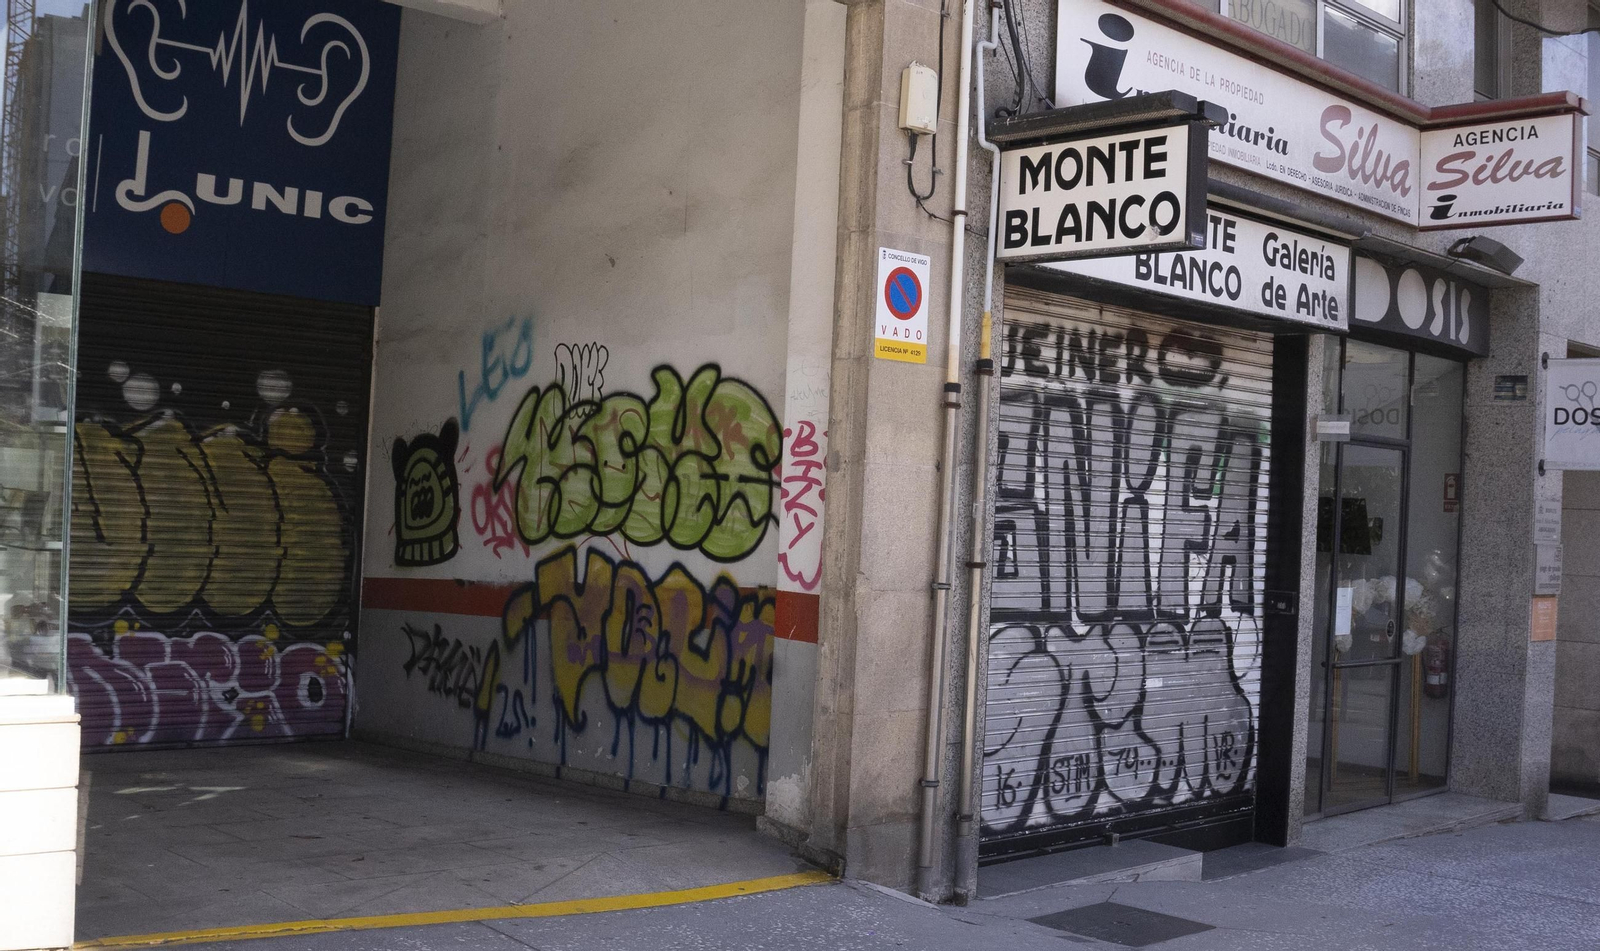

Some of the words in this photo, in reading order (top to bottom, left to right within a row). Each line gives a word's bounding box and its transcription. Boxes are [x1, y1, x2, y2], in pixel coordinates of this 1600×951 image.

[1146, 50, 1185, 76] AGENCIA
[1189, 66, 1201, 82] DE
[1205, 71, 1216, 88] LA
[1219, 77, 1264, 105] PROPIEDAD
[1312, 104, 1412, 198] Silva
[1453, 125, 1539, 148] AGENCIA
[1019, 135, 1168, 195] MONTE
[1228, 148, 1261, 167] INMOBILIARIA
[1280, 165, 1286, 174] EN
[1287, 167, 1307, 182] DERECHO
[1391, 203, 1397, 213] DE
[1397, 205, 1411, 218] FINCAS
[1426, 147, 1566, 191] Silva
[1004, 190, 1181, 249] BLANCO
[888, 253, 911, 263] CONCELLO
[917, 258, 928, 266] VIGO
[1135, 253, 1242, 301] BLANCO
[1263, 232, 1335, 282] Galería
[1261, 276, 1287, 311] de
[1296, 283, 1339, 322] Arte
[1355, 256, 1472, 345] DOSIS
[880, 345, 903, 354] LICENCIA
[881, 324, 922, 341] VADO
